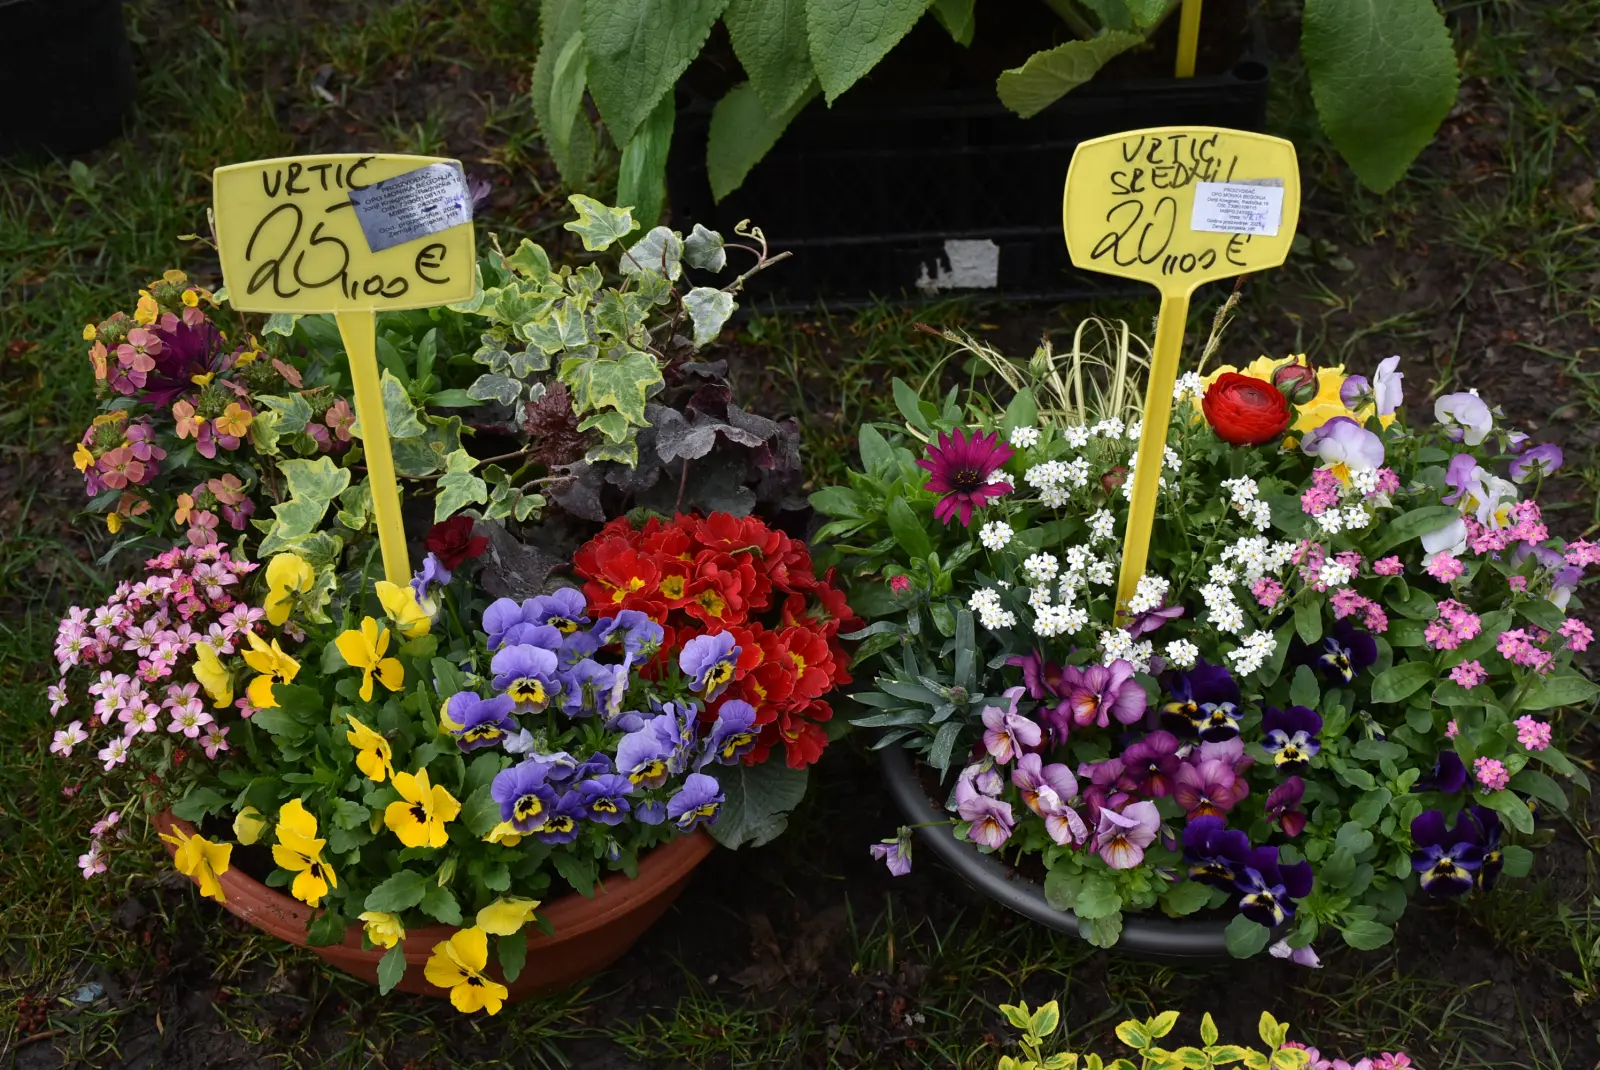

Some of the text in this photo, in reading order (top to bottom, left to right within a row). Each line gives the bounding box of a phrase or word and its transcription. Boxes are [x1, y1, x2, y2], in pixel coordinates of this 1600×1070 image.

[364, 172, 453, 205] OPG MONIKA BEGONJA
[414, 243, 450, 284] €
